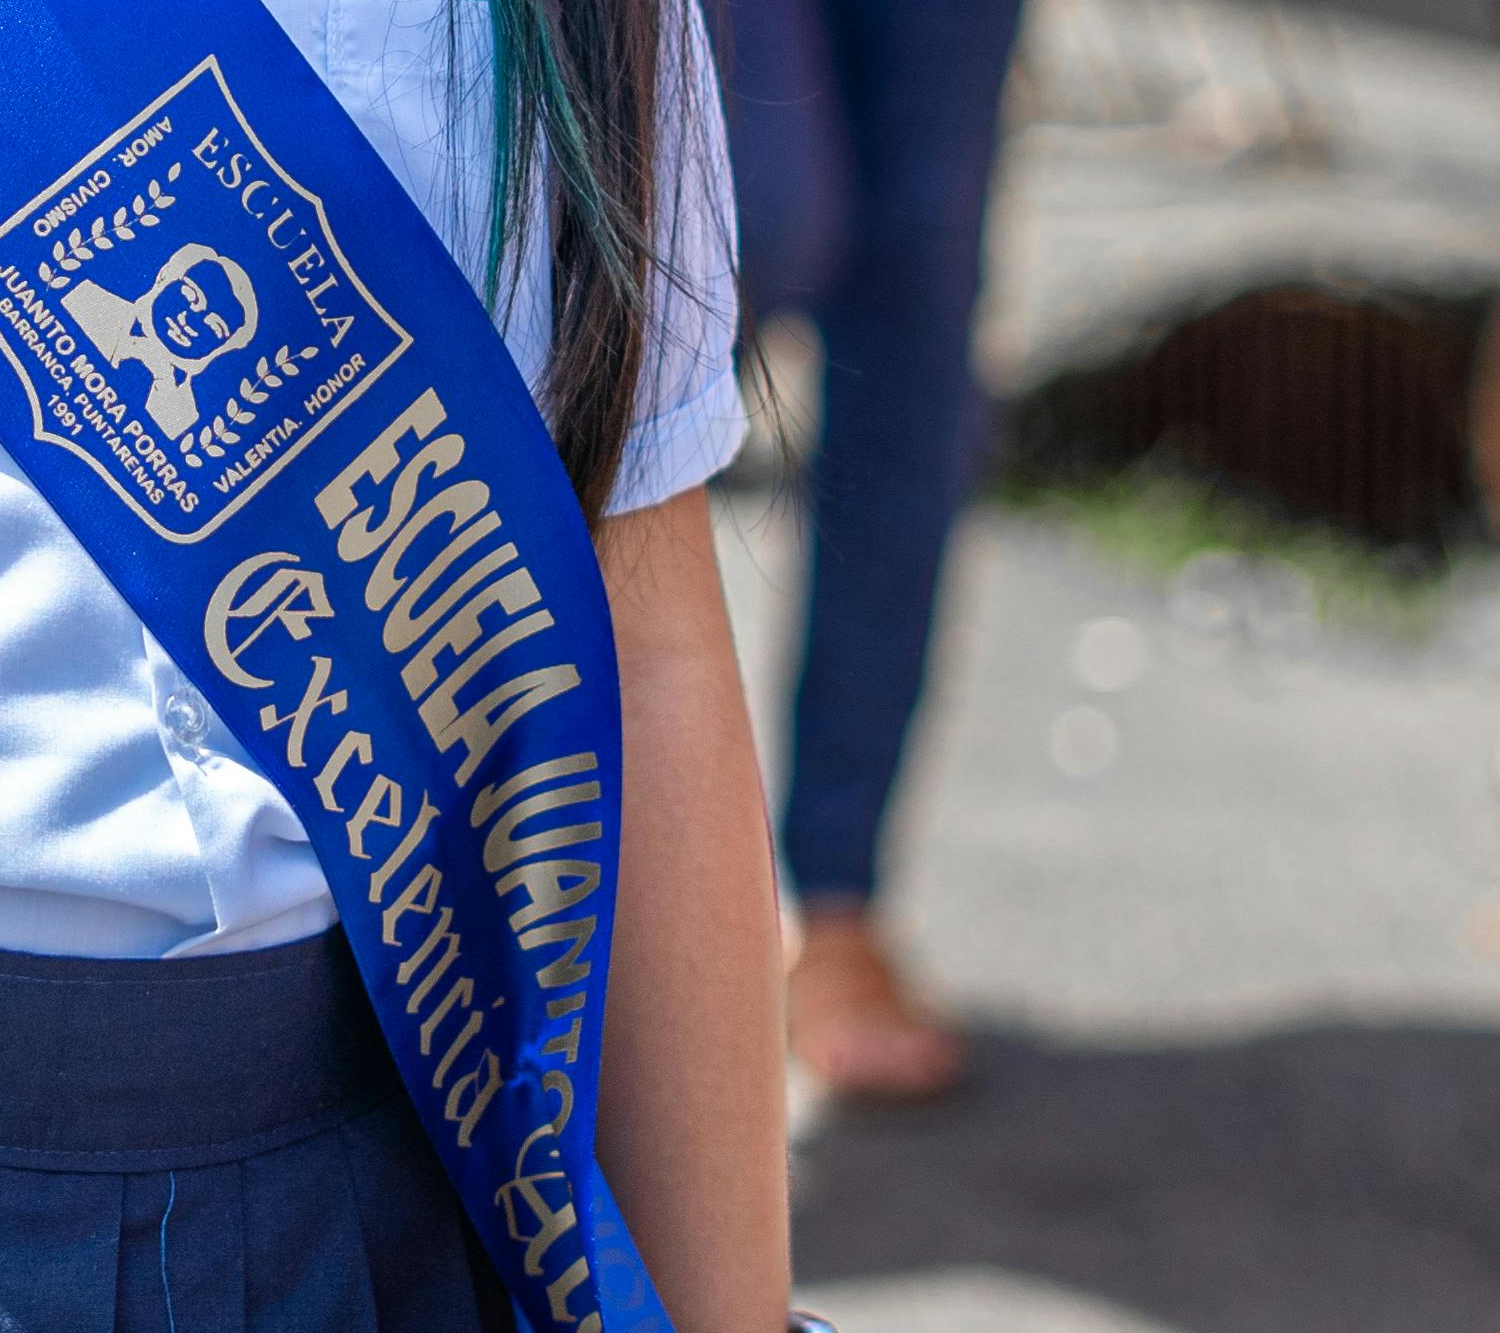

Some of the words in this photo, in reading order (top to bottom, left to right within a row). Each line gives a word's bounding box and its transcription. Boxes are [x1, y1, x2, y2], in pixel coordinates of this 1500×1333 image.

[32, 169, 112, 238] CIVISMO
[190, 126, 356, 349] ESCUELA
[46, 393, 84, 436] 1991
[69, 353, 128, 425] MORA
[122, 419, 200, 514] PORRAS
[73, 392, 166, 506] PUNTARENAS
[303, 352, 367, 416] HONOR
[313, 385, 582, 789] ESCUELA
[203, 550, 506, 1149] Excelencia
